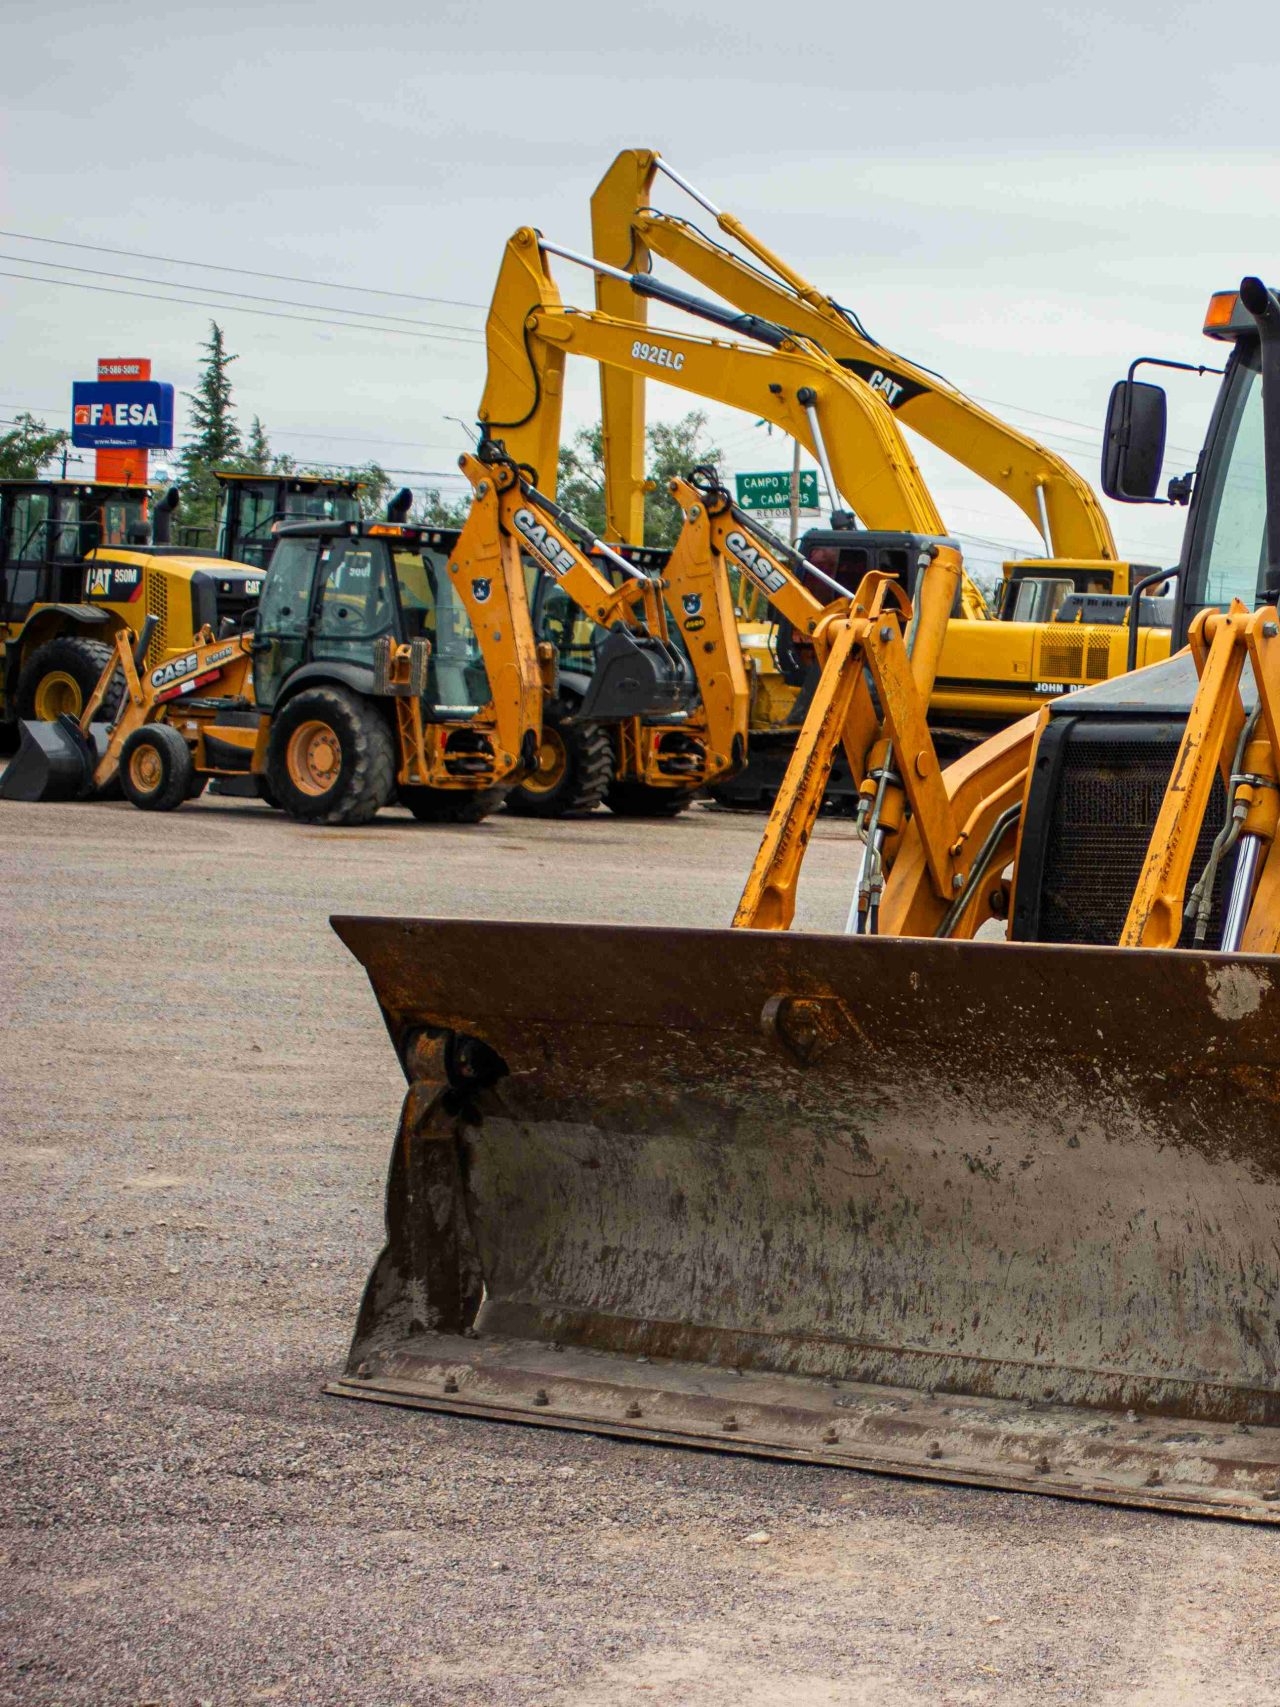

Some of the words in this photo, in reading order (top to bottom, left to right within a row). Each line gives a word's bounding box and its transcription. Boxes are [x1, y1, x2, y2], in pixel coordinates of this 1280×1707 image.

[631, 341, 685, 370] 892ELC
[869, 370, 903, 405] CAT
[90, 403, 158, 426] FAESA
[744, 477, 779, 489] CAMPO
[761, 492, 792, 505] CAMP
[757, 509, 801, 518] RETOR
[514, 508, 577, 576] CASE
[726, 531, 788, 593] CASE
[85, 568, 112, 595] CAT
[114, 569, 138, 583] 950M
[245, 580, 260, 595] CAT
[151, 652, 198, 687] CASE
[1035, 683, 1064, 693] JOHN
